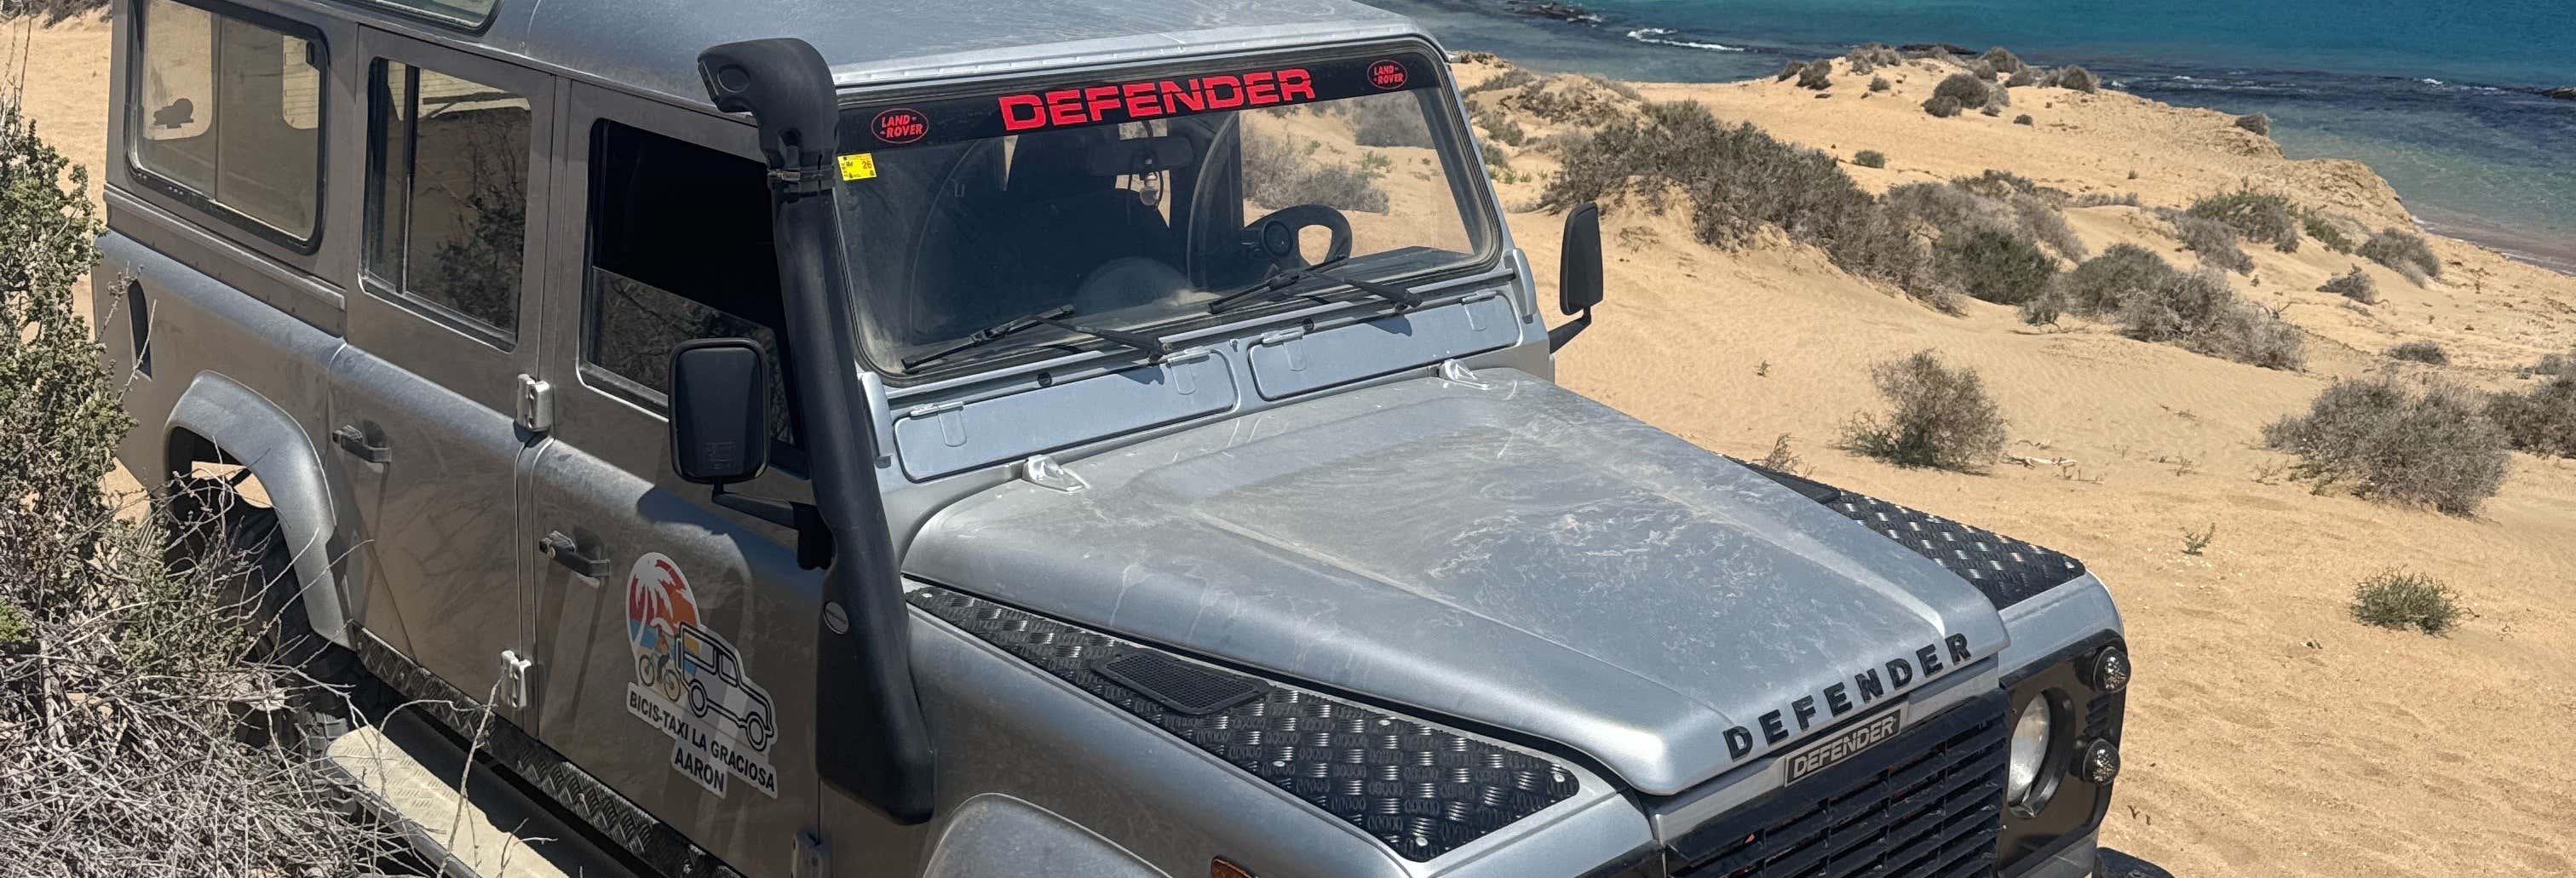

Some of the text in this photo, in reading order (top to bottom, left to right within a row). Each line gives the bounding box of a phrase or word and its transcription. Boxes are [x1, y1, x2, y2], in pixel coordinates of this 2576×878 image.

[998, 68, 1315, 131] DEFENDER
[1722, 633, 1972, 762] DEFENDER
[630, 691, 775, 792] BICIS-TAXI LA GRACIOSA
[675, 747, 724, 792] AARON
[1793, 716, 1897, 778] DEFENDER
